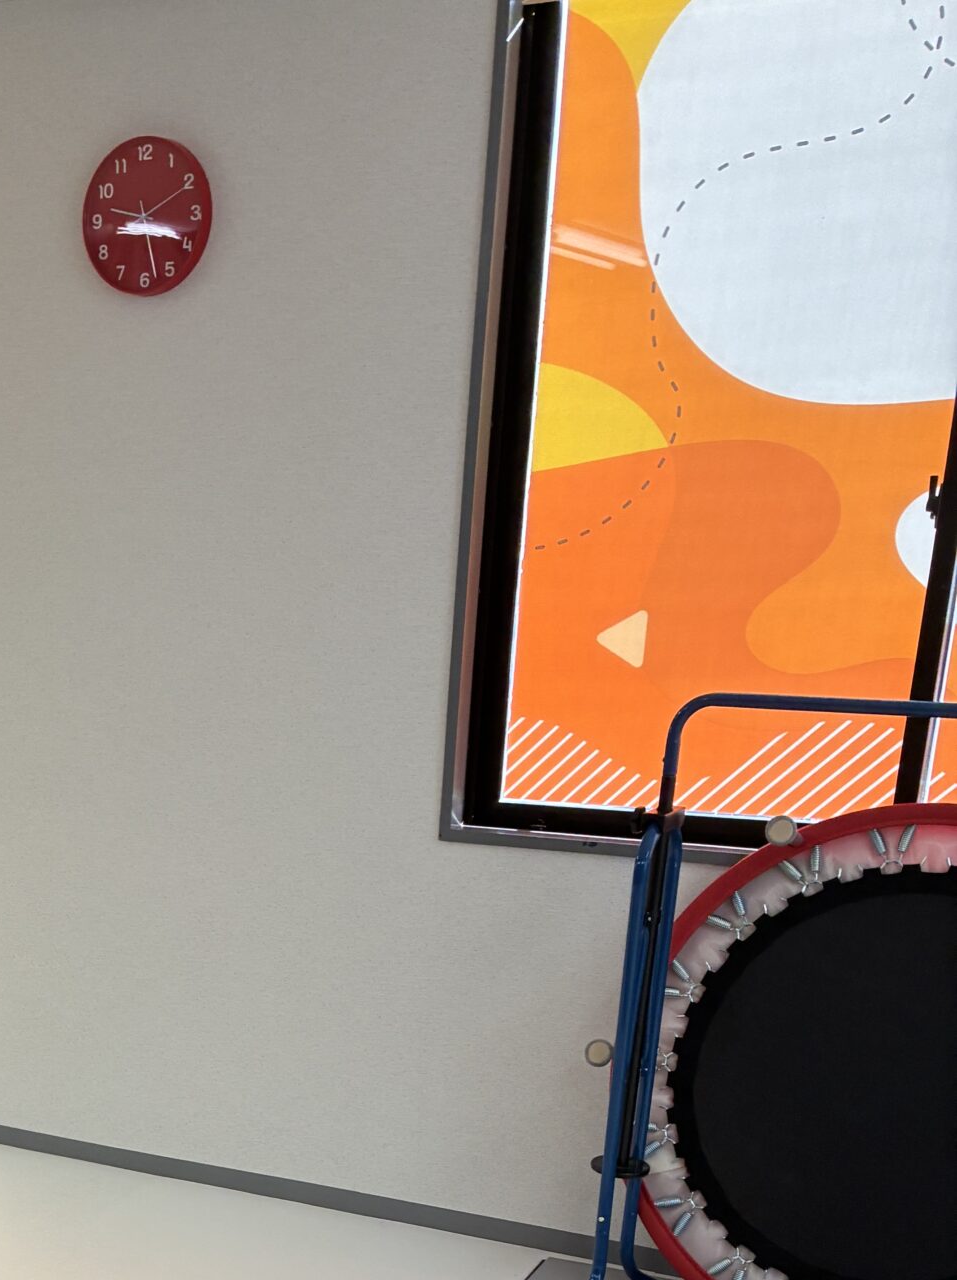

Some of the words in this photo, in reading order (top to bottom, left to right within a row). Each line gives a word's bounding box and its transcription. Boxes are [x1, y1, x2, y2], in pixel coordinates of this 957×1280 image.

[138, 144, 153, 161] 12
[115, 158, 127, 174] 11
[183, 173, 195, 190] 2
[98, 183, 114, 199] 10
[190, 205, 202, 221] 3
[92, 214, 103, 230] 9
[98, 244, 109, 260] 8
[182, 236, 192, 252] 4
[116, 265, 125, 281] 7
[165, 261, 175, 277] 5
[139, 272, 150, 288] 6
